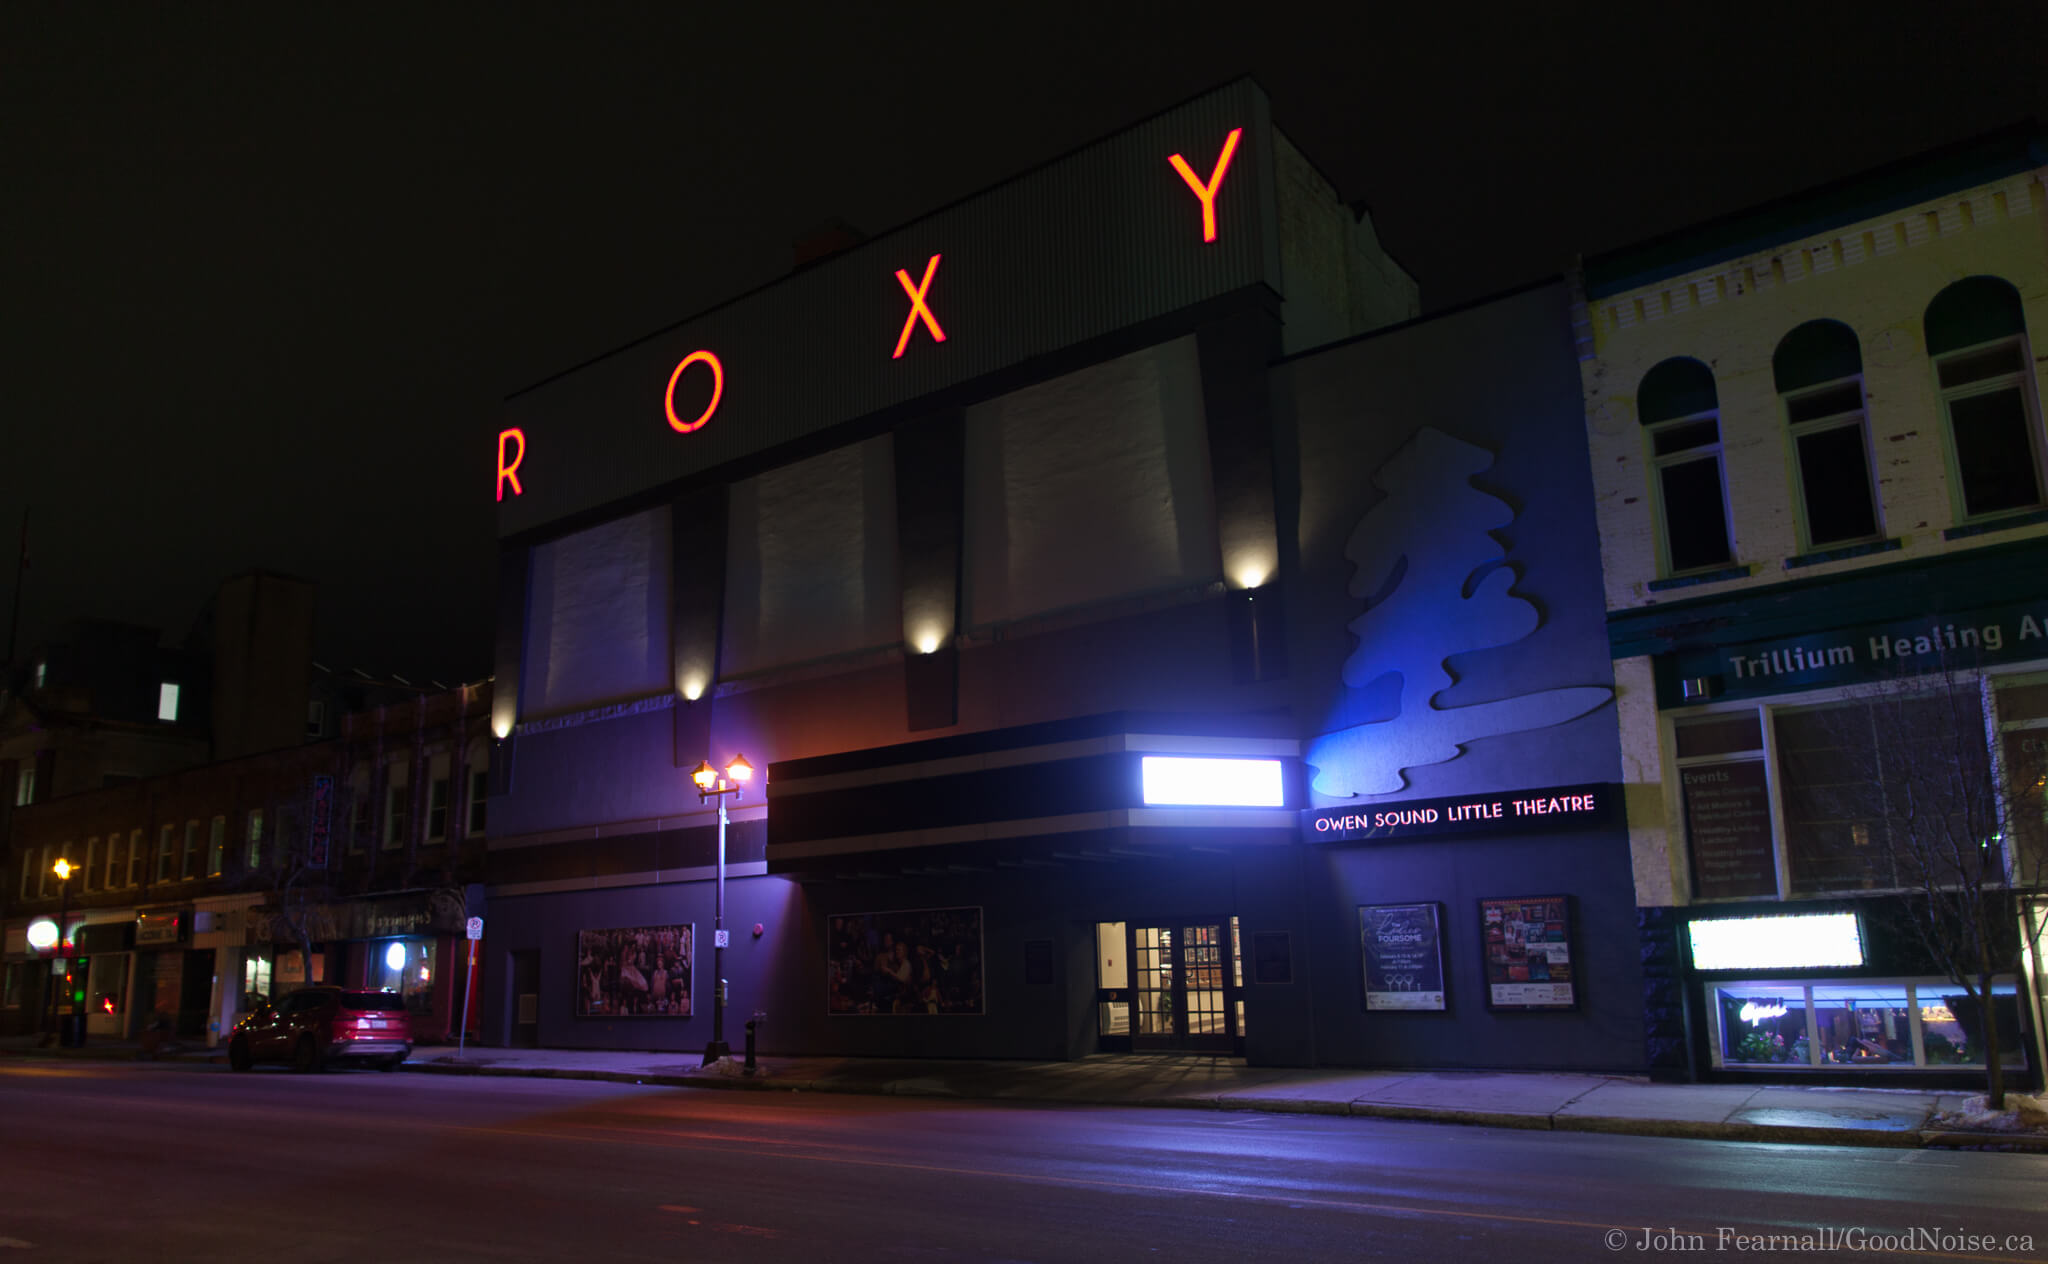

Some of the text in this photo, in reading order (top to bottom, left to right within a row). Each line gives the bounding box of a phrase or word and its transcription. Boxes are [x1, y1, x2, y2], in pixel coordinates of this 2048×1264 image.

[1729, 646, 1855, 679] Trillium
[1868, 623, 2003, 661] Healing
[1683, 770, 1729, 784] Events
[1315, 794, 1596, 833] OWEN SOUND LITTLE THEATRE
[1378, 934, 1422, 943] FOURSOME
